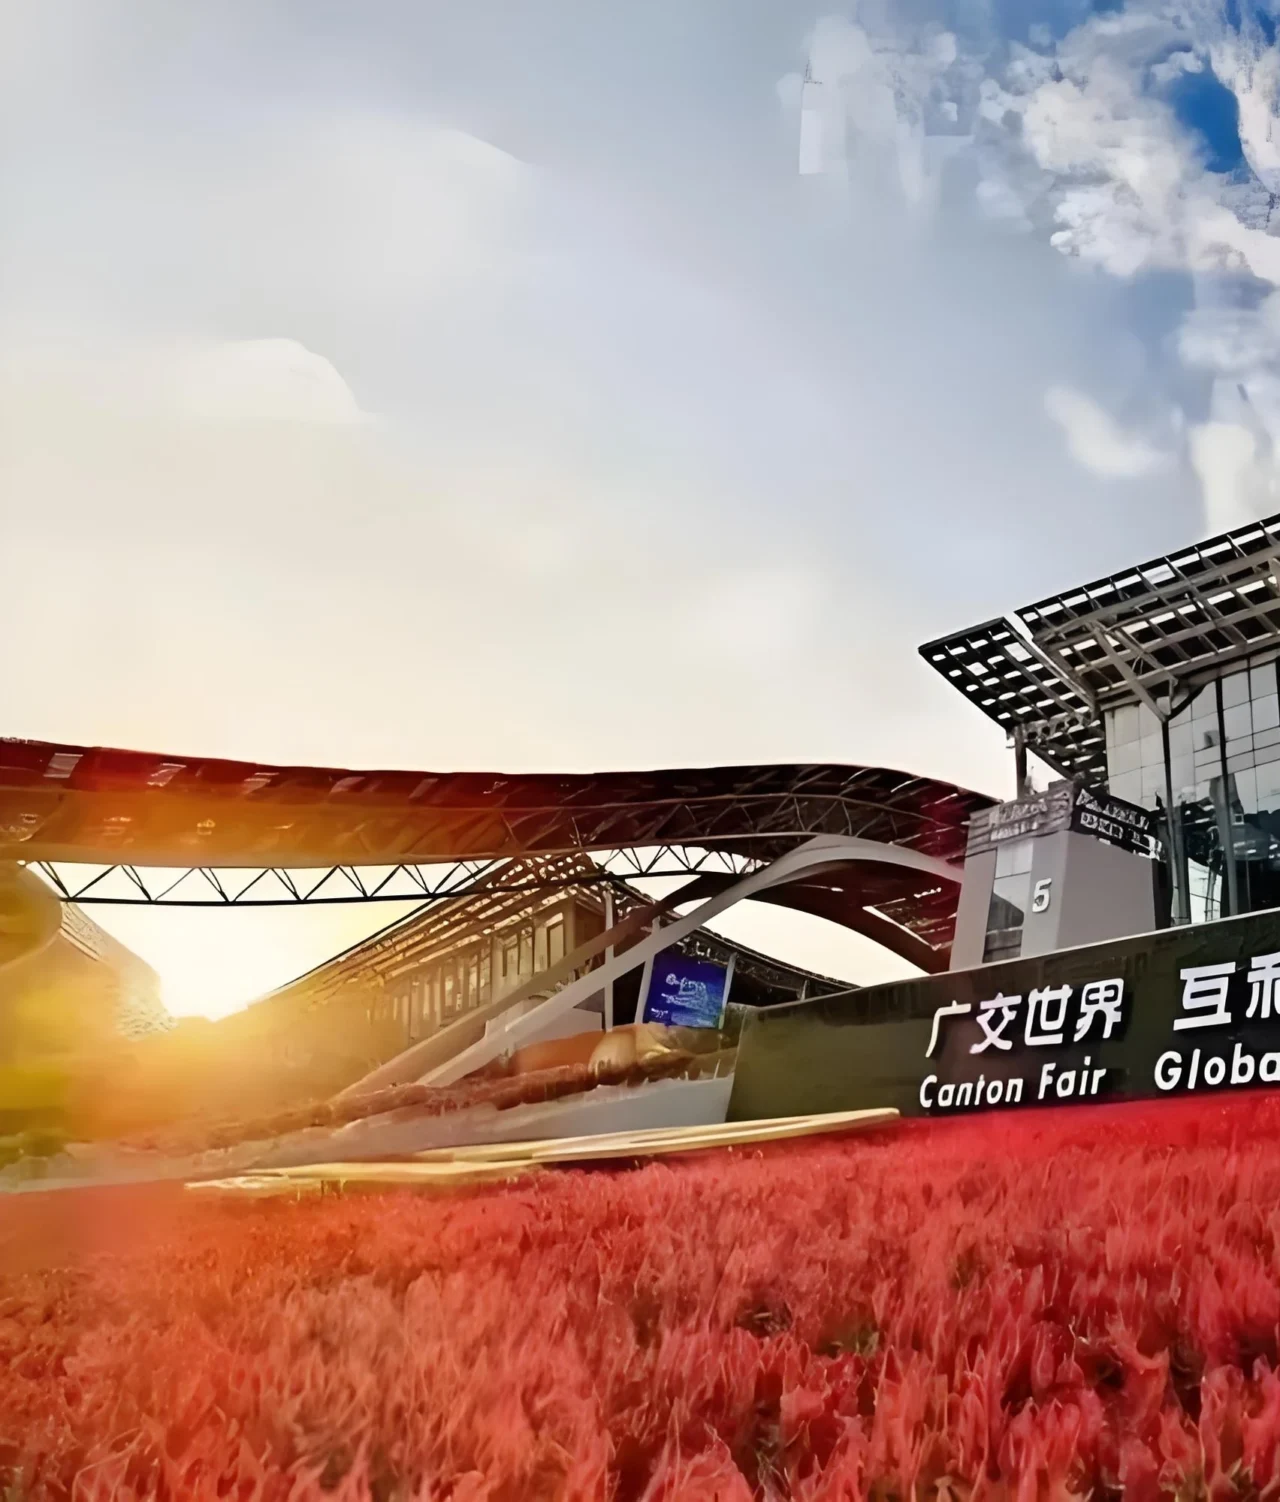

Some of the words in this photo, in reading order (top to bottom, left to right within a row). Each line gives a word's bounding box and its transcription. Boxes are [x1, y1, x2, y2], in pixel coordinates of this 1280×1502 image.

[1032, 878, 1052, 913] 5
[925, 978, 1125, 1058] 广交世界
[919, 1074, 1024, 1108] Canton
[1038, 1055, 1107, 1100] Fair
